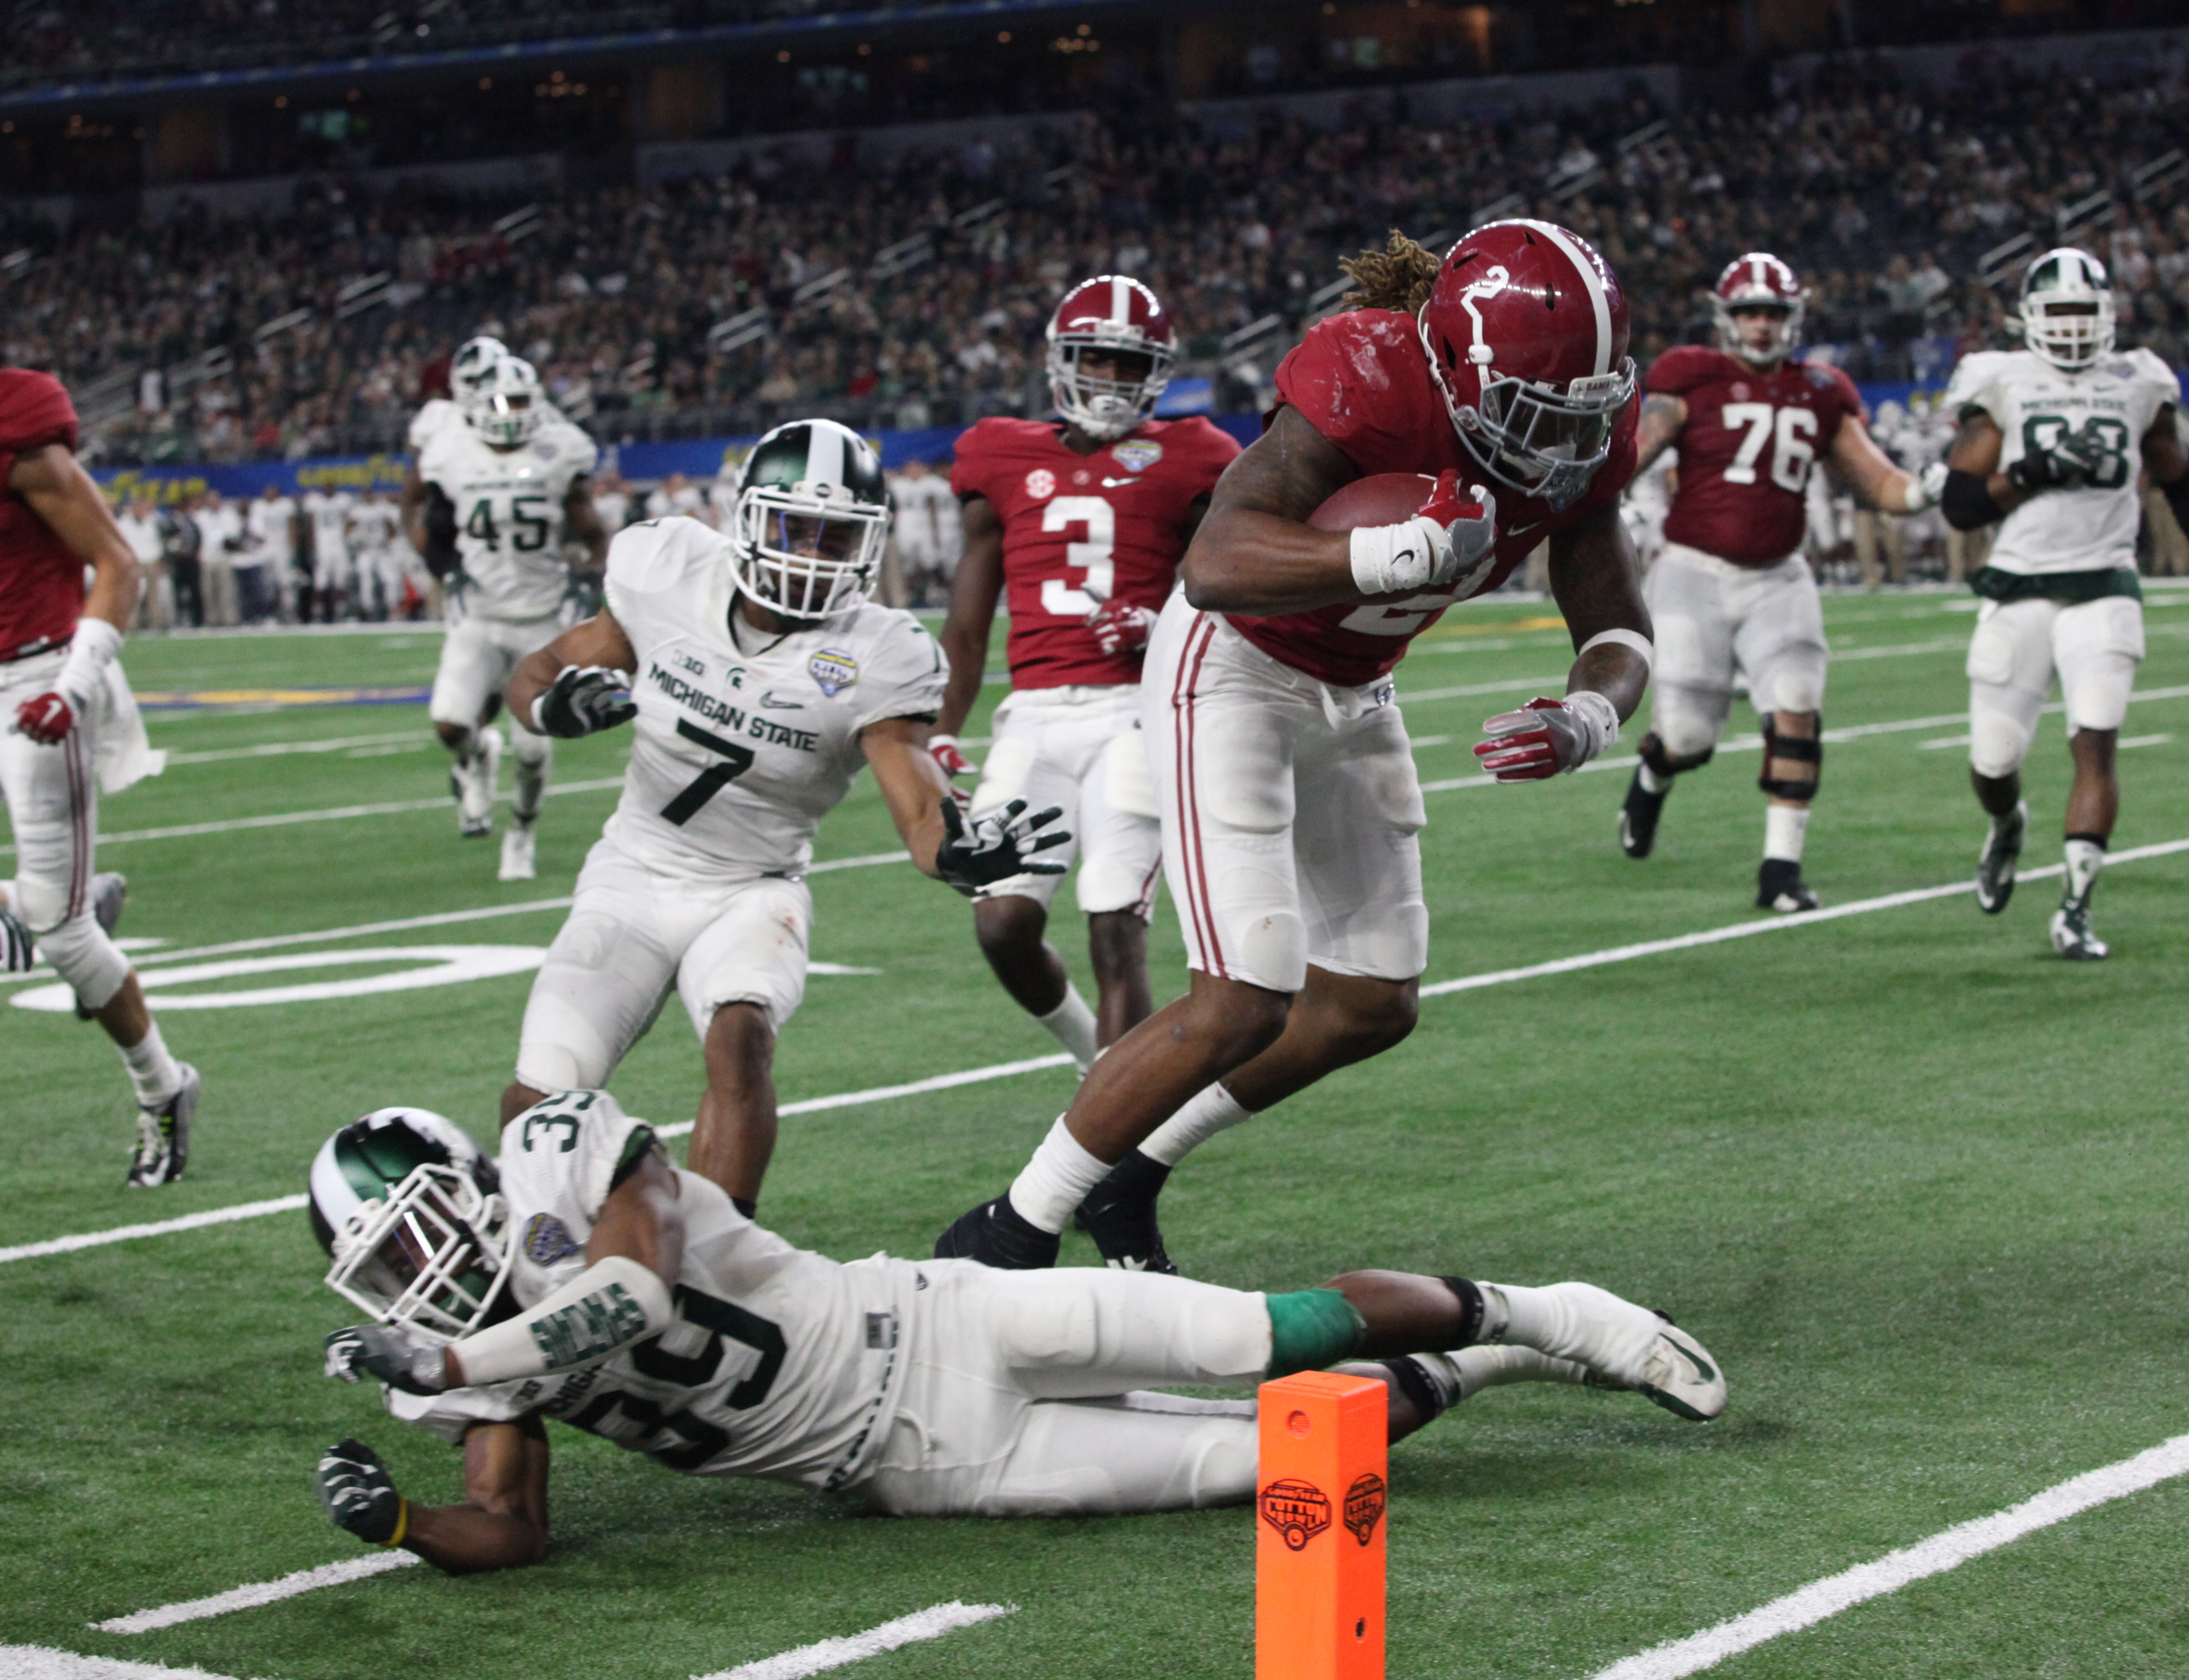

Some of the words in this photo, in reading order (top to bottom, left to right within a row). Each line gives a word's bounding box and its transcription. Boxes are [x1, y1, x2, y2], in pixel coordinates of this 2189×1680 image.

[1721, 401, 1819, 493] 76
[466, 496, 550, 552] 45
[1041, 495, 1115, 616] 3
[648, 661, 746, 731] MICHIGAN
[749, 717, 819, 752] STATE
[661, 717, 755, 827] 7
[554, 1282, 787, 1470] 39
